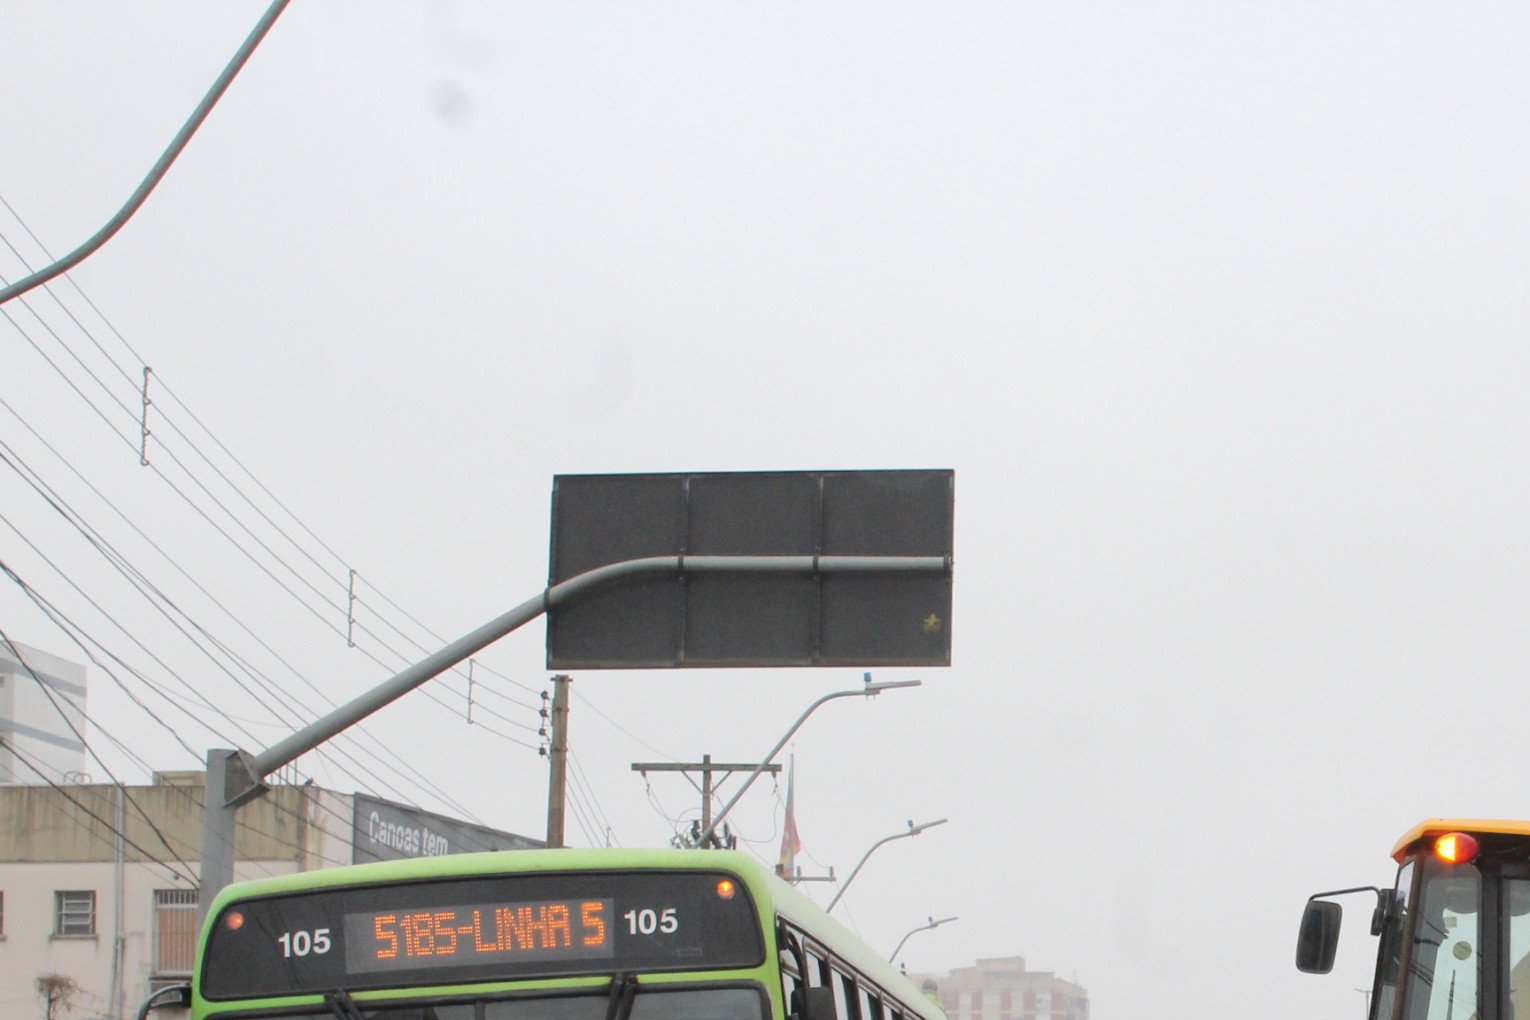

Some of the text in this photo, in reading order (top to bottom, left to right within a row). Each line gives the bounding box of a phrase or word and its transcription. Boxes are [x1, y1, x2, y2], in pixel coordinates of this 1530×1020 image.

[369, 811, 449, 857] Canoas tem
[374, 901, 606, 959] 5185-LINHA 5
[624, 908, 679, 935] 105
[278, 928, 331, 958] 105
